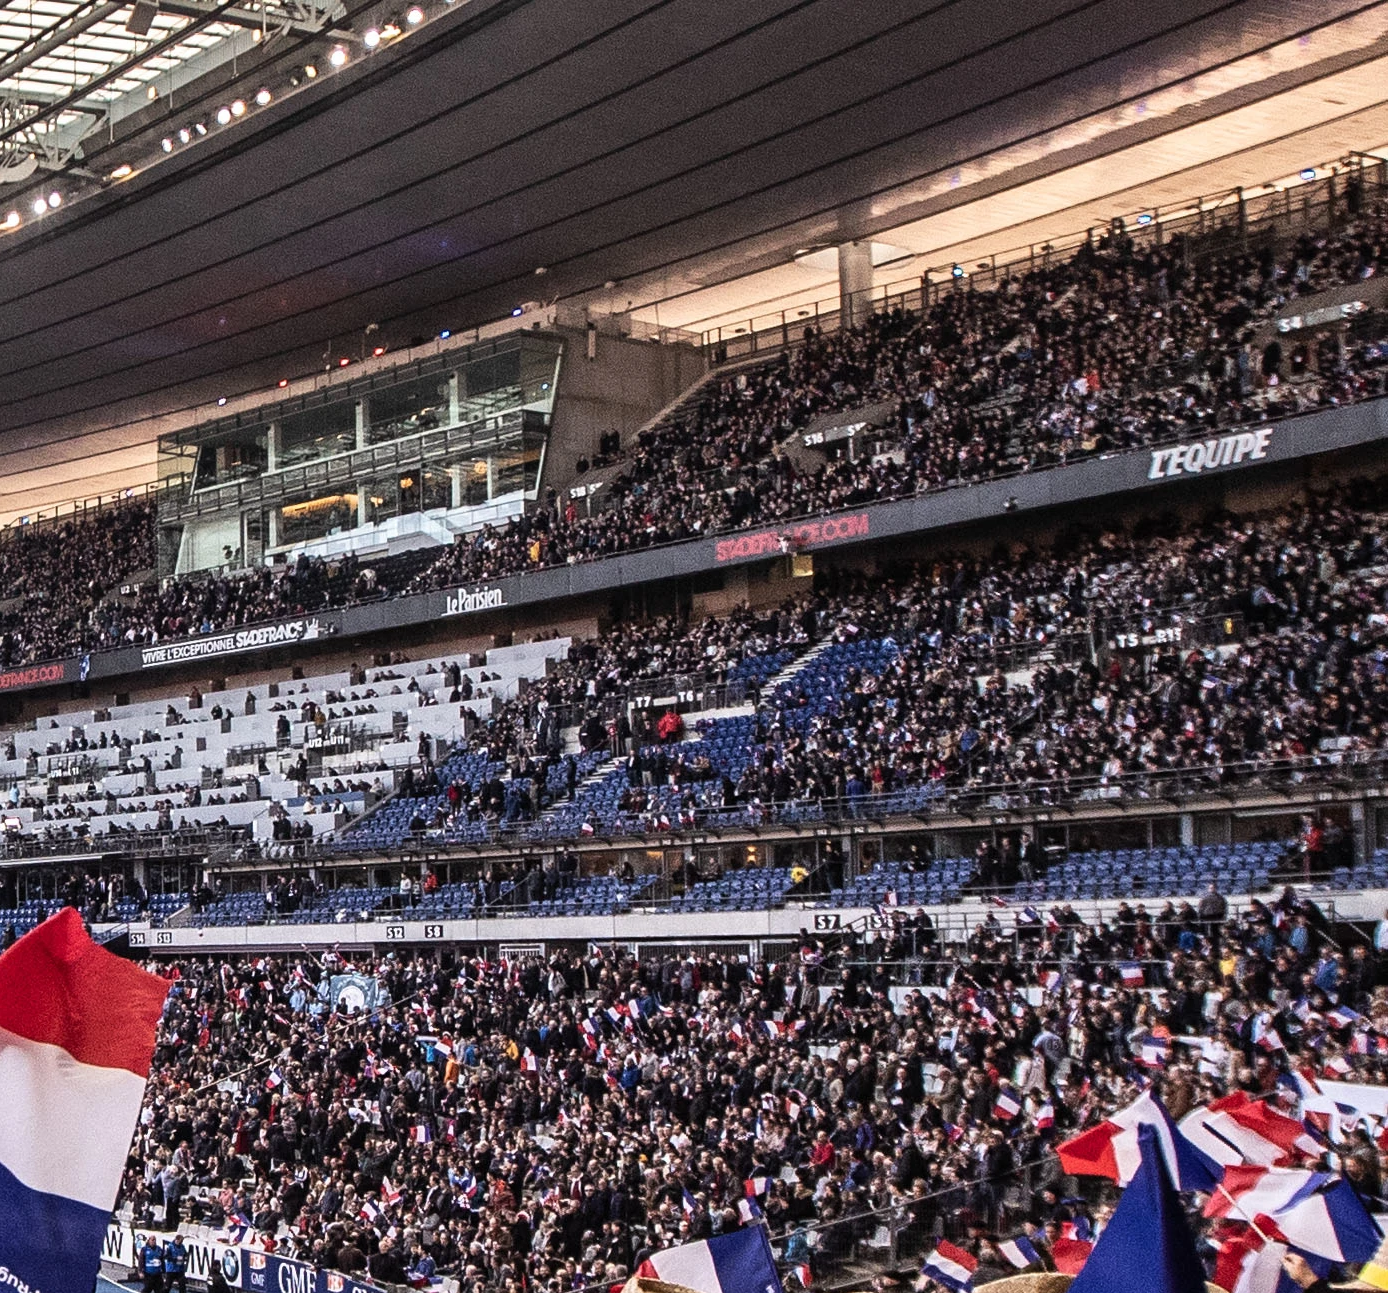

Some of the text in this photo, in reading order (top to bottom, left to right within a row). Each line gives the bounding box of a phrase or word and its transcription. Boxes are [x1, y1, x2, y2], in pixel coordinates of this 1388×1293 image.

[1148, 428, 1273, 480] L'EQUIPE
[458, 587, 503, 612] Parisien
[142, 650, 166, 665] VIVRE
[167, 638, 235, 661] L'EXCEPTIONNEL
[817, 916, 836, 929] S7
[387, 927, 403, 938] S12
[426, 925, 442, 937] S8
[131, 933, 145, 944] S14
[158, 933, 171, 943] S13
[250, 1272, 265, 1287] GMF
